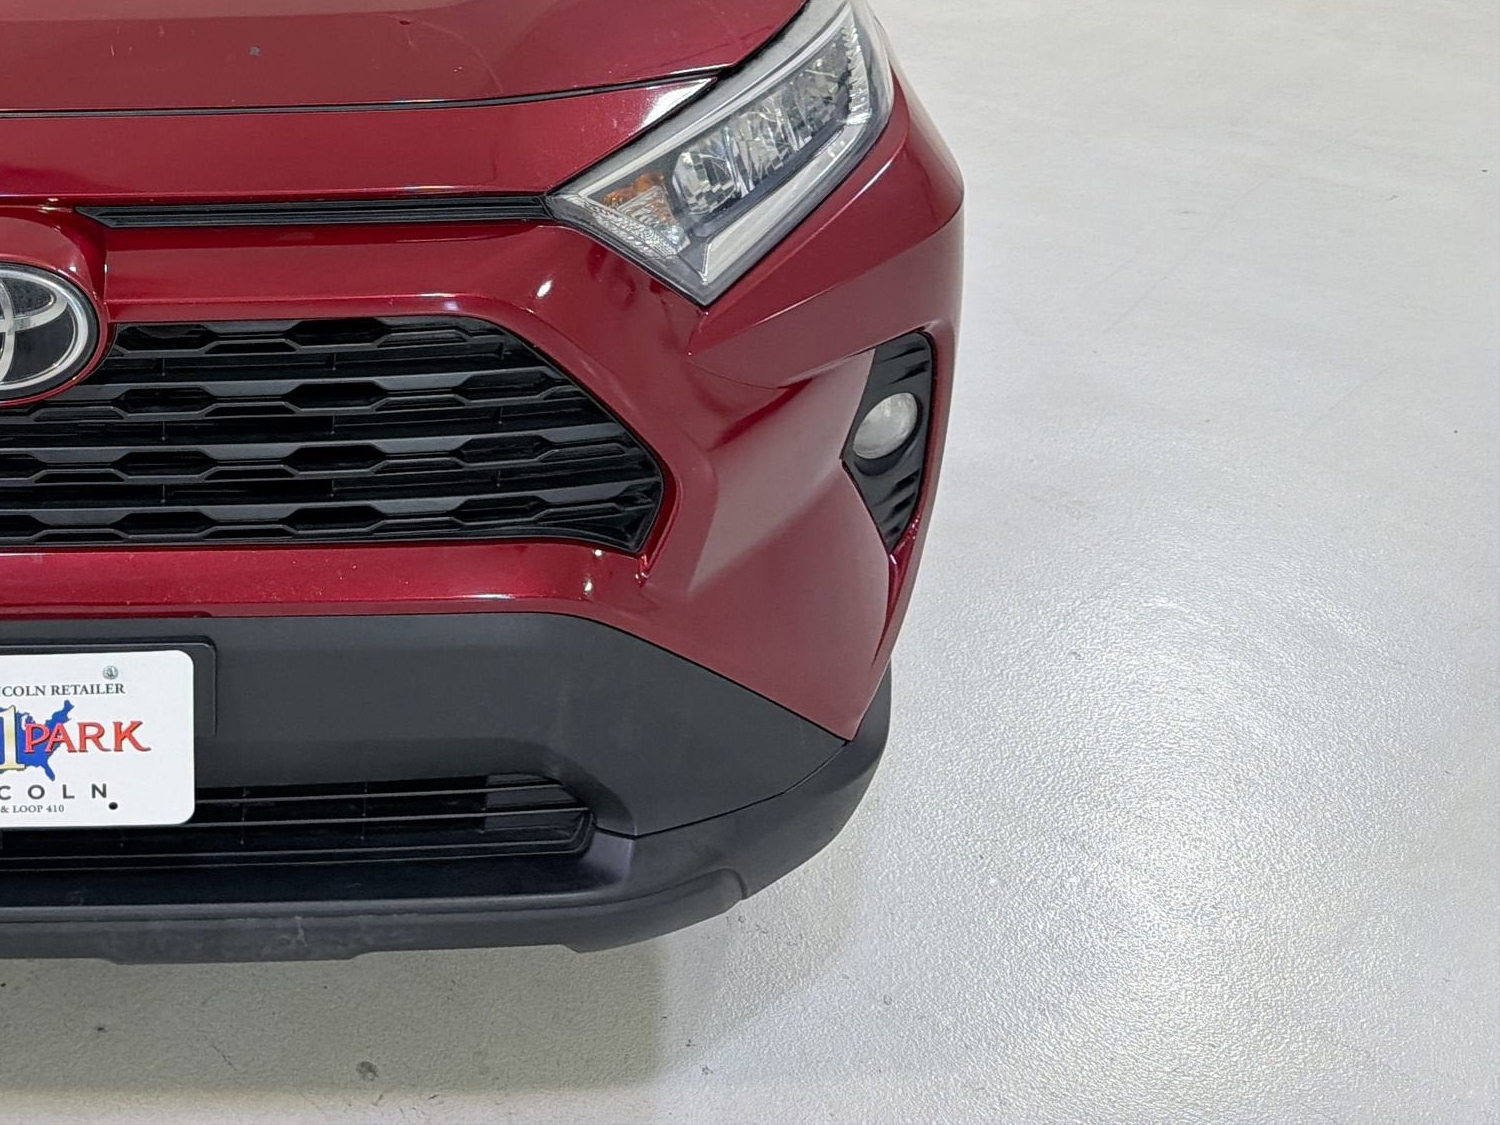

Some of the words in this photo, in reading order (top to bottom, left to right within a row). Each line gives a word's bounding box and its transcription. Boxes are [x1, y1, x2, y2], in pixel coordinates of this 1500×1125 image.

[50, 682, 126, 696] RETAILER
[23, 721, 152, 754] PARK
[0, 806, 10, 814] &
[12, 804, 43, 814] LOOP
[46, 804, 65, 813] 410
